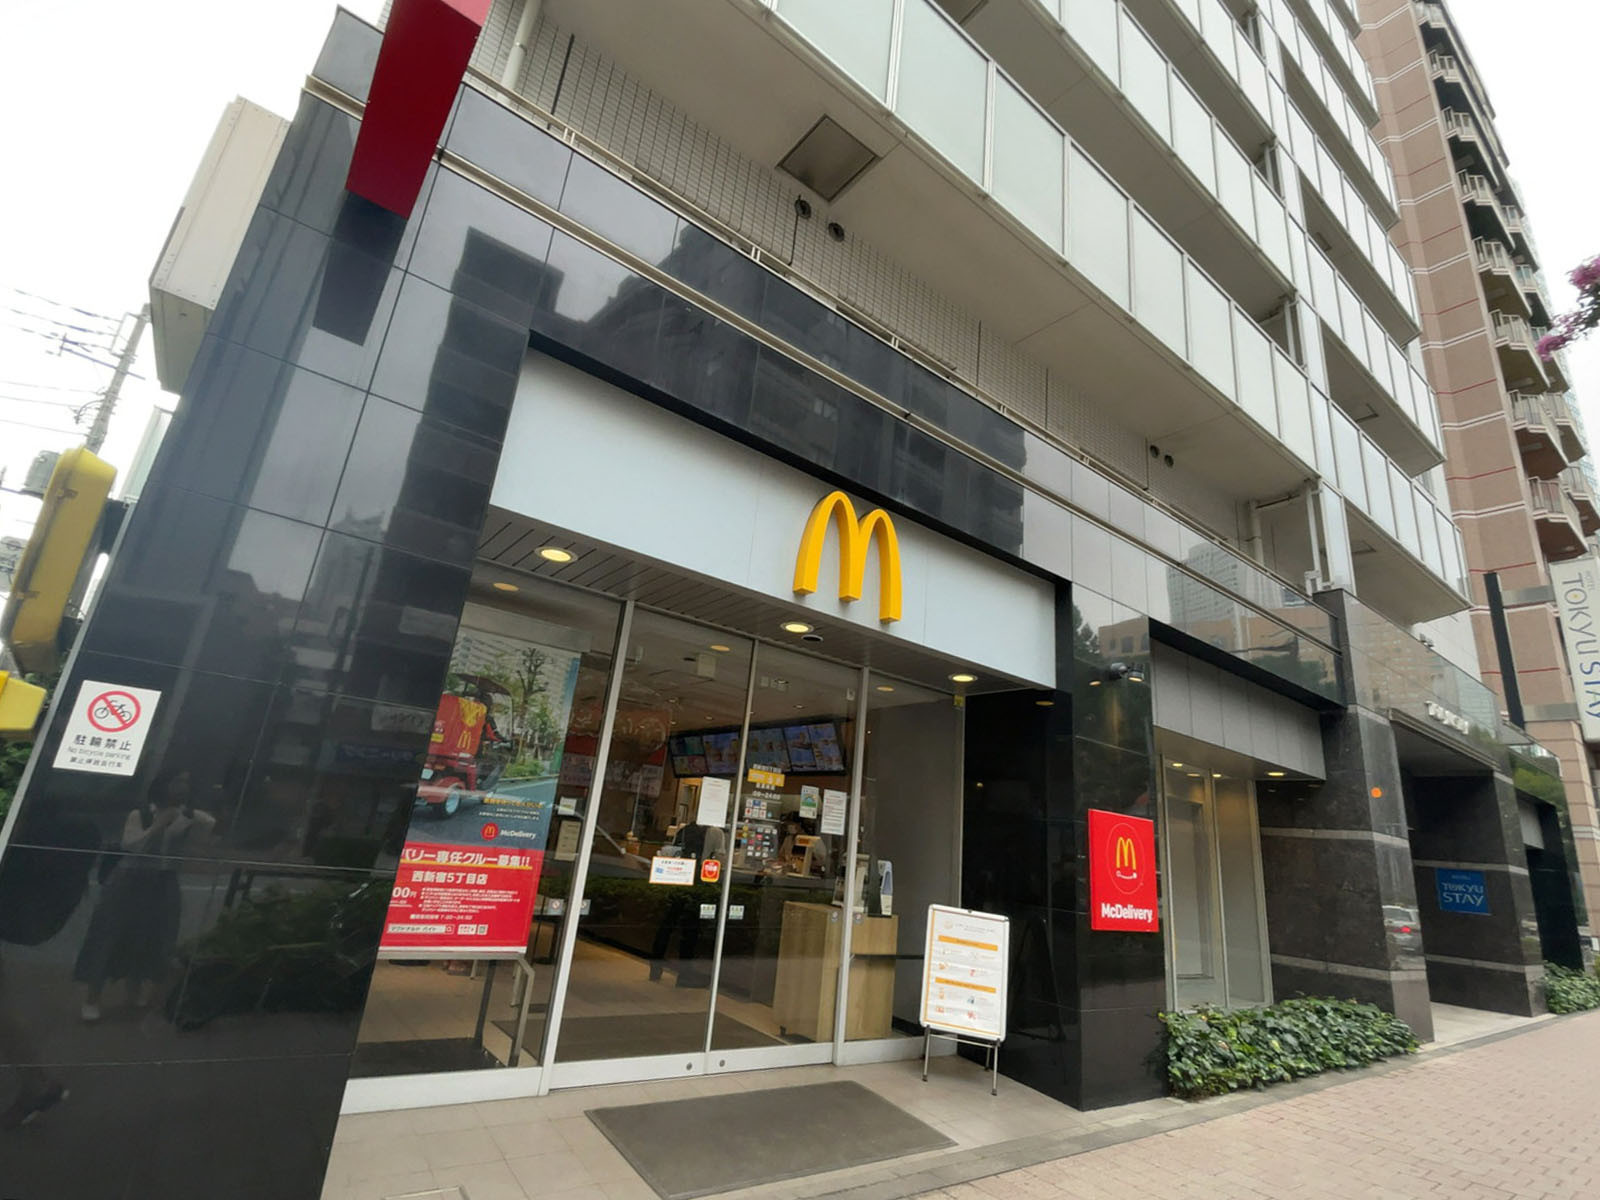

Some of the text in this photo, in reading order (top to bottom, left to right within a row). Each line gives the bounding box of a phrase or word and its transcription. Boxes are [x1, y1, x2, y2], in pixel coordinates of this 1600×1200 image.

[1562, 572, 1599, 655] TOKYU
[411, 870, 488, 885] 西新宿5丁目店
[1442, 891, 1485, 907] STAY
[1101, 902, 1153, 924] McDelivery
